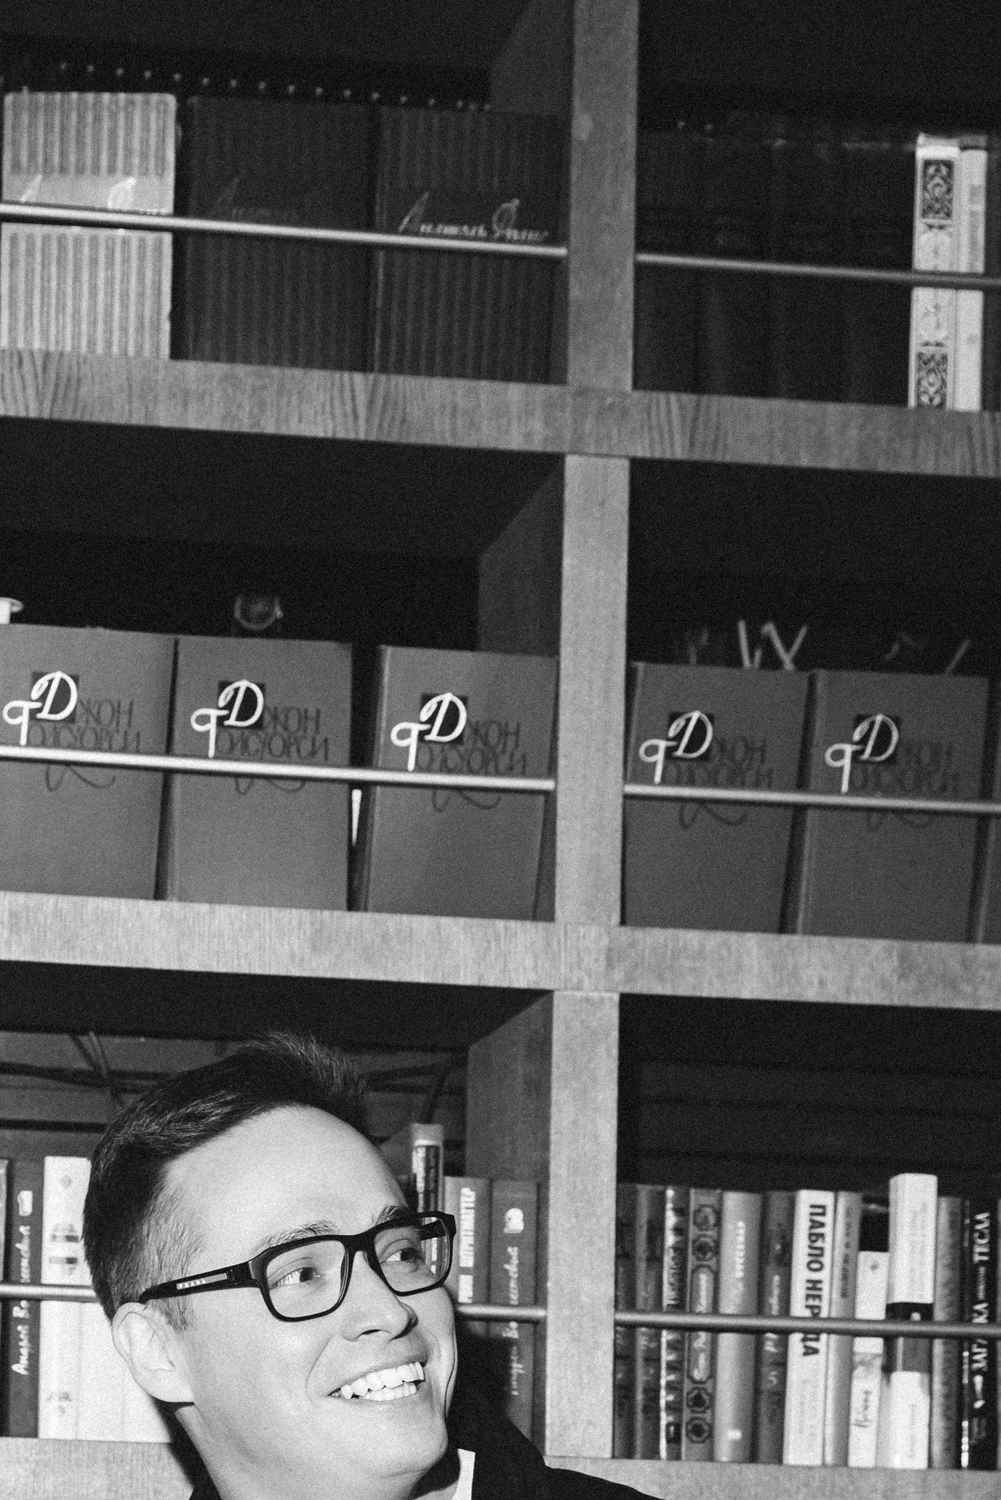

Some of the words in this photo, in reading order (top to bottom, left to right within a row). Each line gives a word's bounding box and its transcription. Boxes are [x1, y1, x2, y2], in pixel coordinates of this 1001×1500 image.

[806, 1204, 827, 1273] ПАБЛО
[801, 1279, 824, 1357] НЕРДА
[971, 1302, 989, 1372] ЗАГКА
